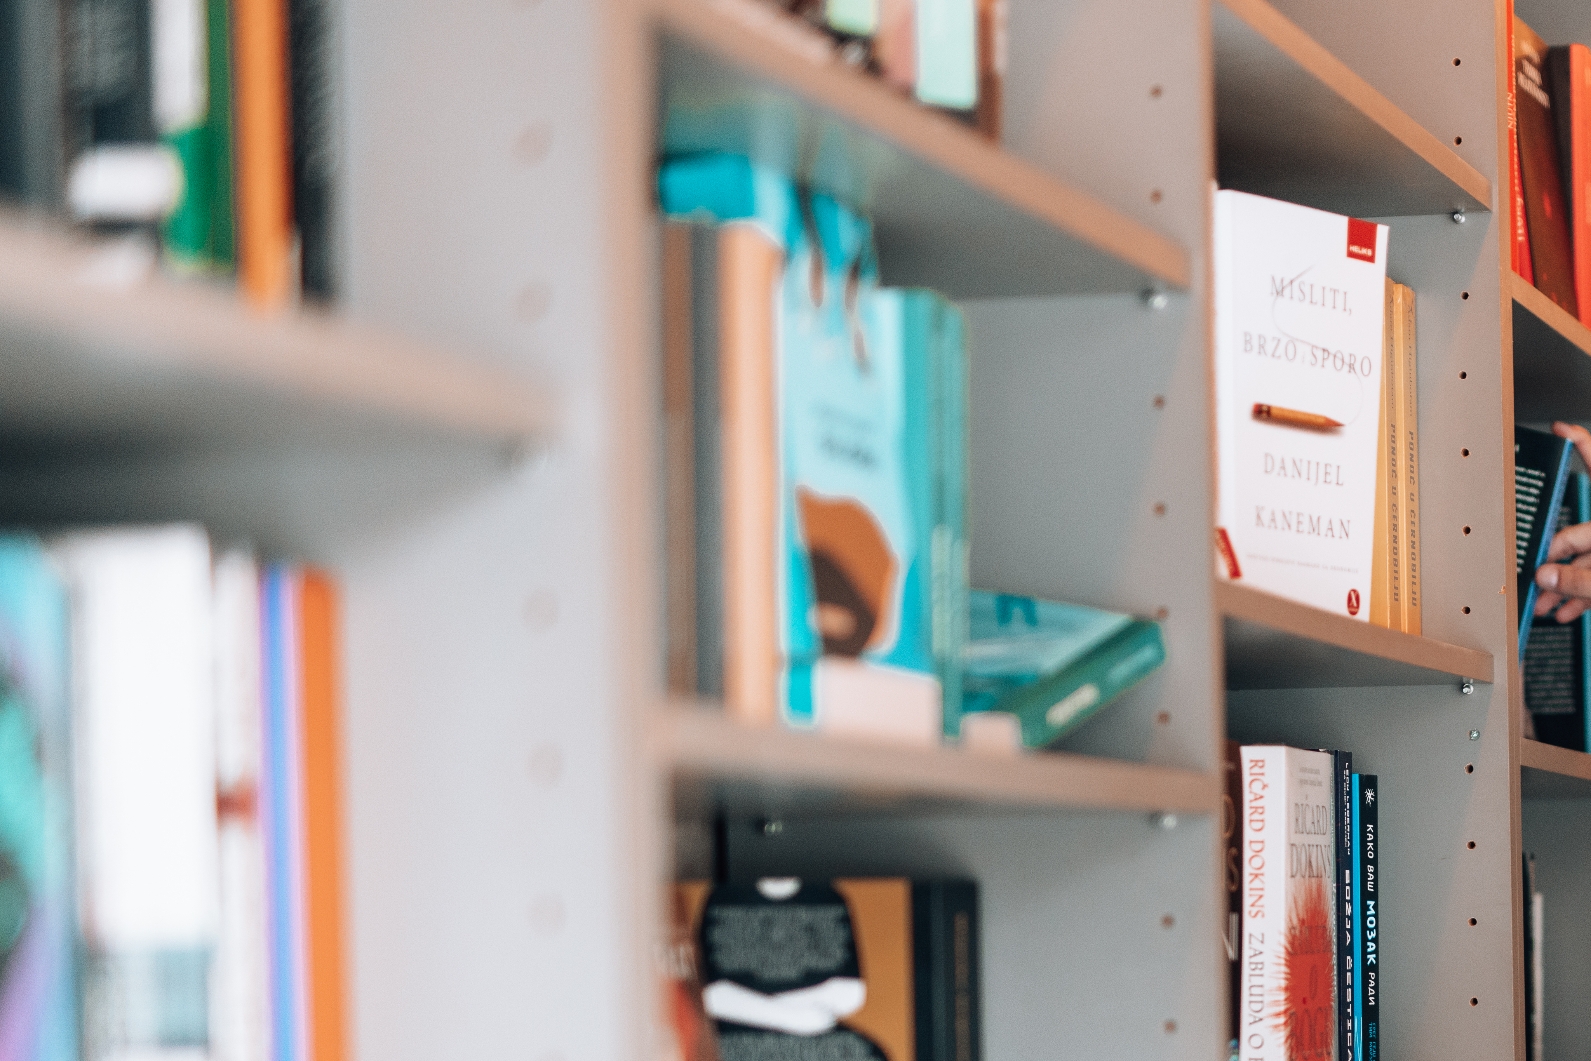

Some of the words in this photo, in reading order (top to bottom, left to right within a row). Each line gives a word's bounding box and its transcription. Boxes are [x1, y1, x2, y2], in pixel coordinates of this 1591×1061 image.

[1243, 331, 1297, 362] BRZO
[1310, 345, 1372, 377] SPORO
[1264, 452, 1344, 487] DANIJEL
[1255, 505, 1350, 539] KANEMAN
[1248, 759, 1269, 833] RIČARD
[1366, 824, 1375, 859] КАКО
[1289, 843, 1331, 879] DOKINS
[1367, 865, 1375, 892] ВАШ
[1248, 840, 1265, 919] DOKINS
[1366, 900, 1377, 966] МОЗАК
[1248, 932, 1265, 1026] ZABLUDA
[1367, 972, 1376, 1006] РАДИ
[1247, 1033, 1265, 1051] O
